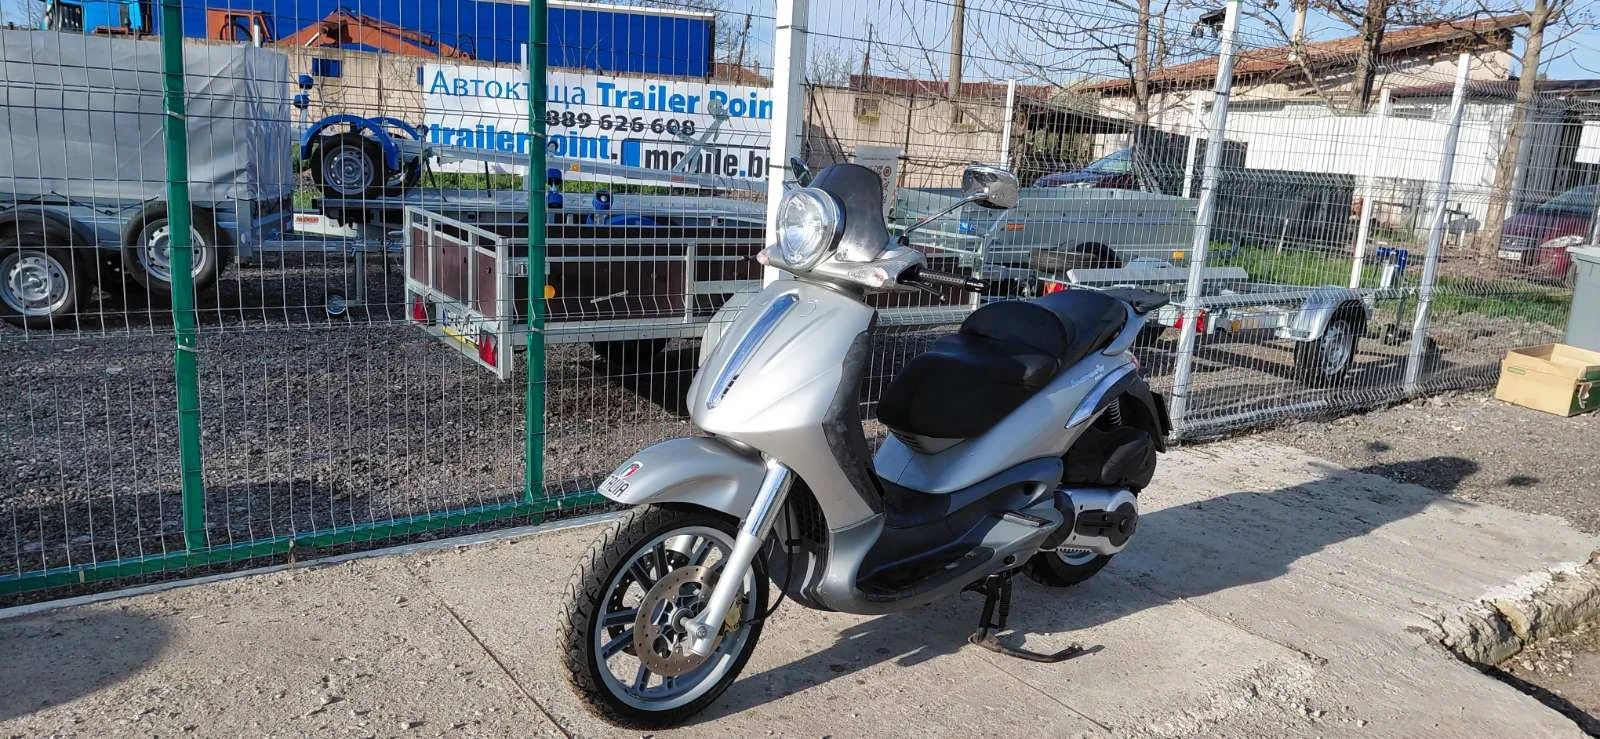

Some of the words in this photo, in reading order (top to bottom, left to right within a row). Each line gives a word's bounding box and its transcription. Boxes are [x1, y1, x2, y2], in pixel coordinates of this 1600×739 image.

[597, 82, 701, 114] Trailer
[600, 114, 644, 132] 626
[650, 118, 695, 136] 608
[429, 123, 618, 160] traileroint.
[645, 148, 770, 180] moile.b
